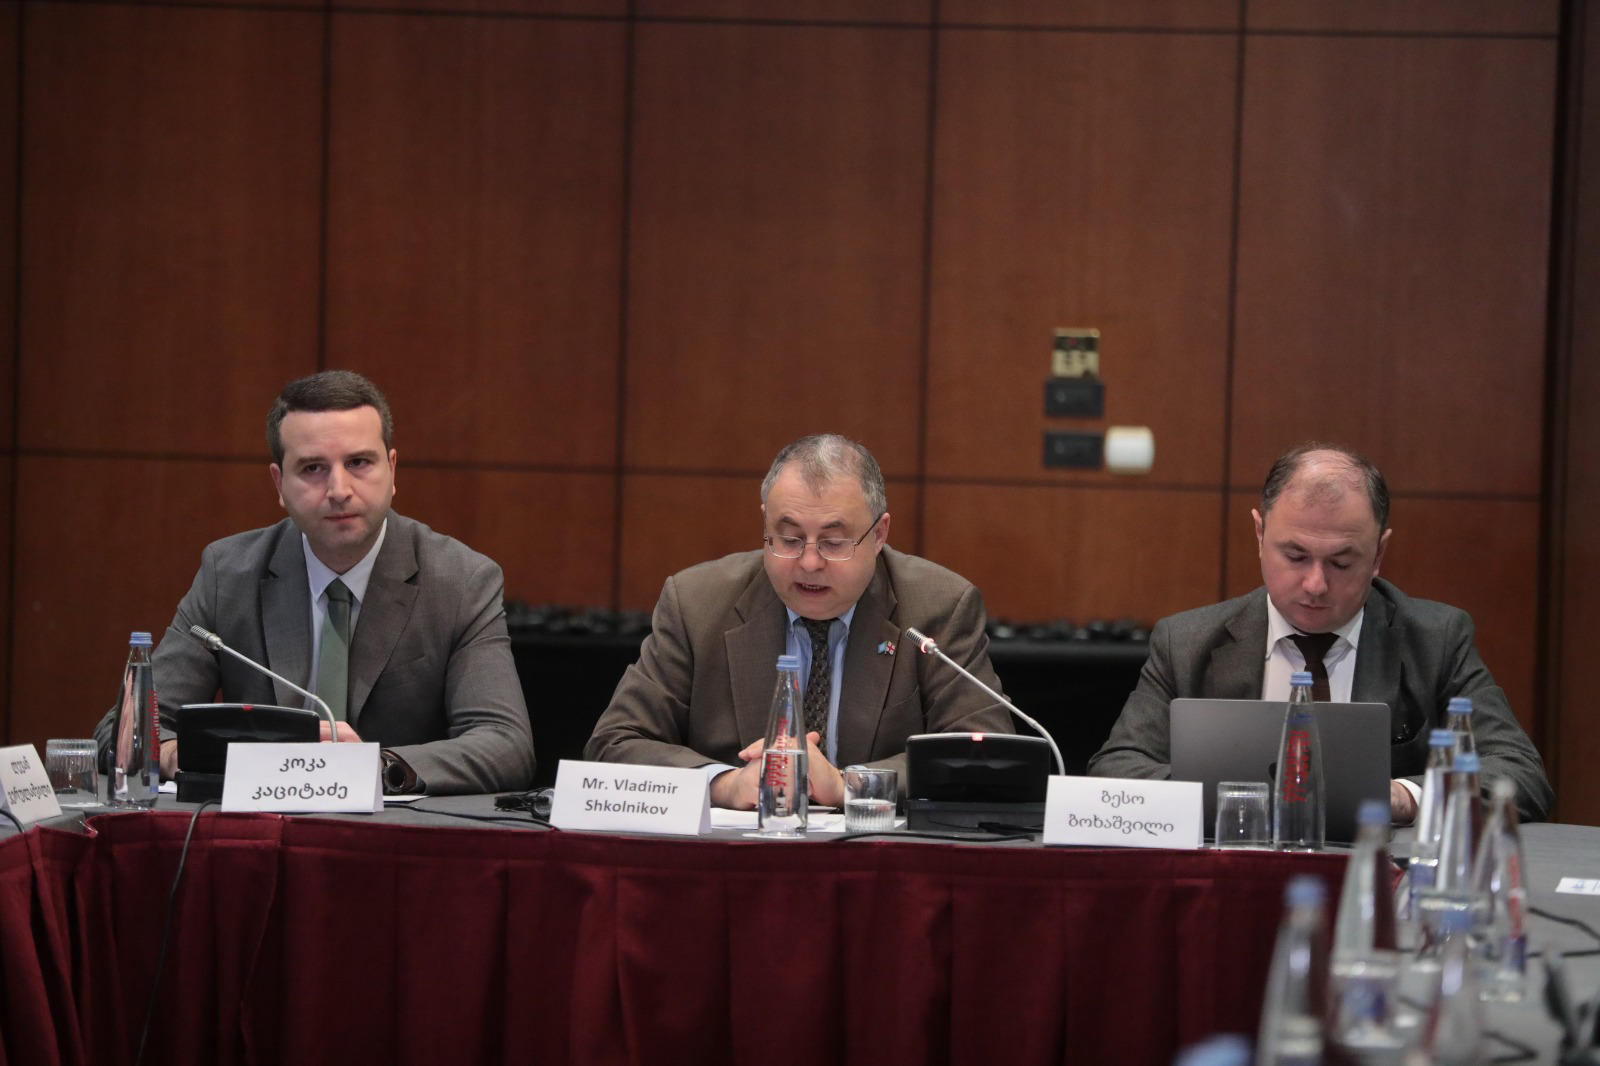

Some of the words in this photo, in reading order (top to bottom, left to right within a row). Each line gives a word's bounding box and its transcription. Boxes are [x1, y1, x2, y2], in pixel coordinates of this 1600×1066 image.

[280, 758, 326, 772] კოკა
[252, 782, 348, 800] კაციტაძე
[582, 777, 608, 790] Mr.
[614, 779, 678, 794] Vladimir
[584, 799, 669, 815] Shkolnikov
[1101, 790, 1145, 808] ბესო
[1068, 813, 1174, 836] ბოხაშვილი
